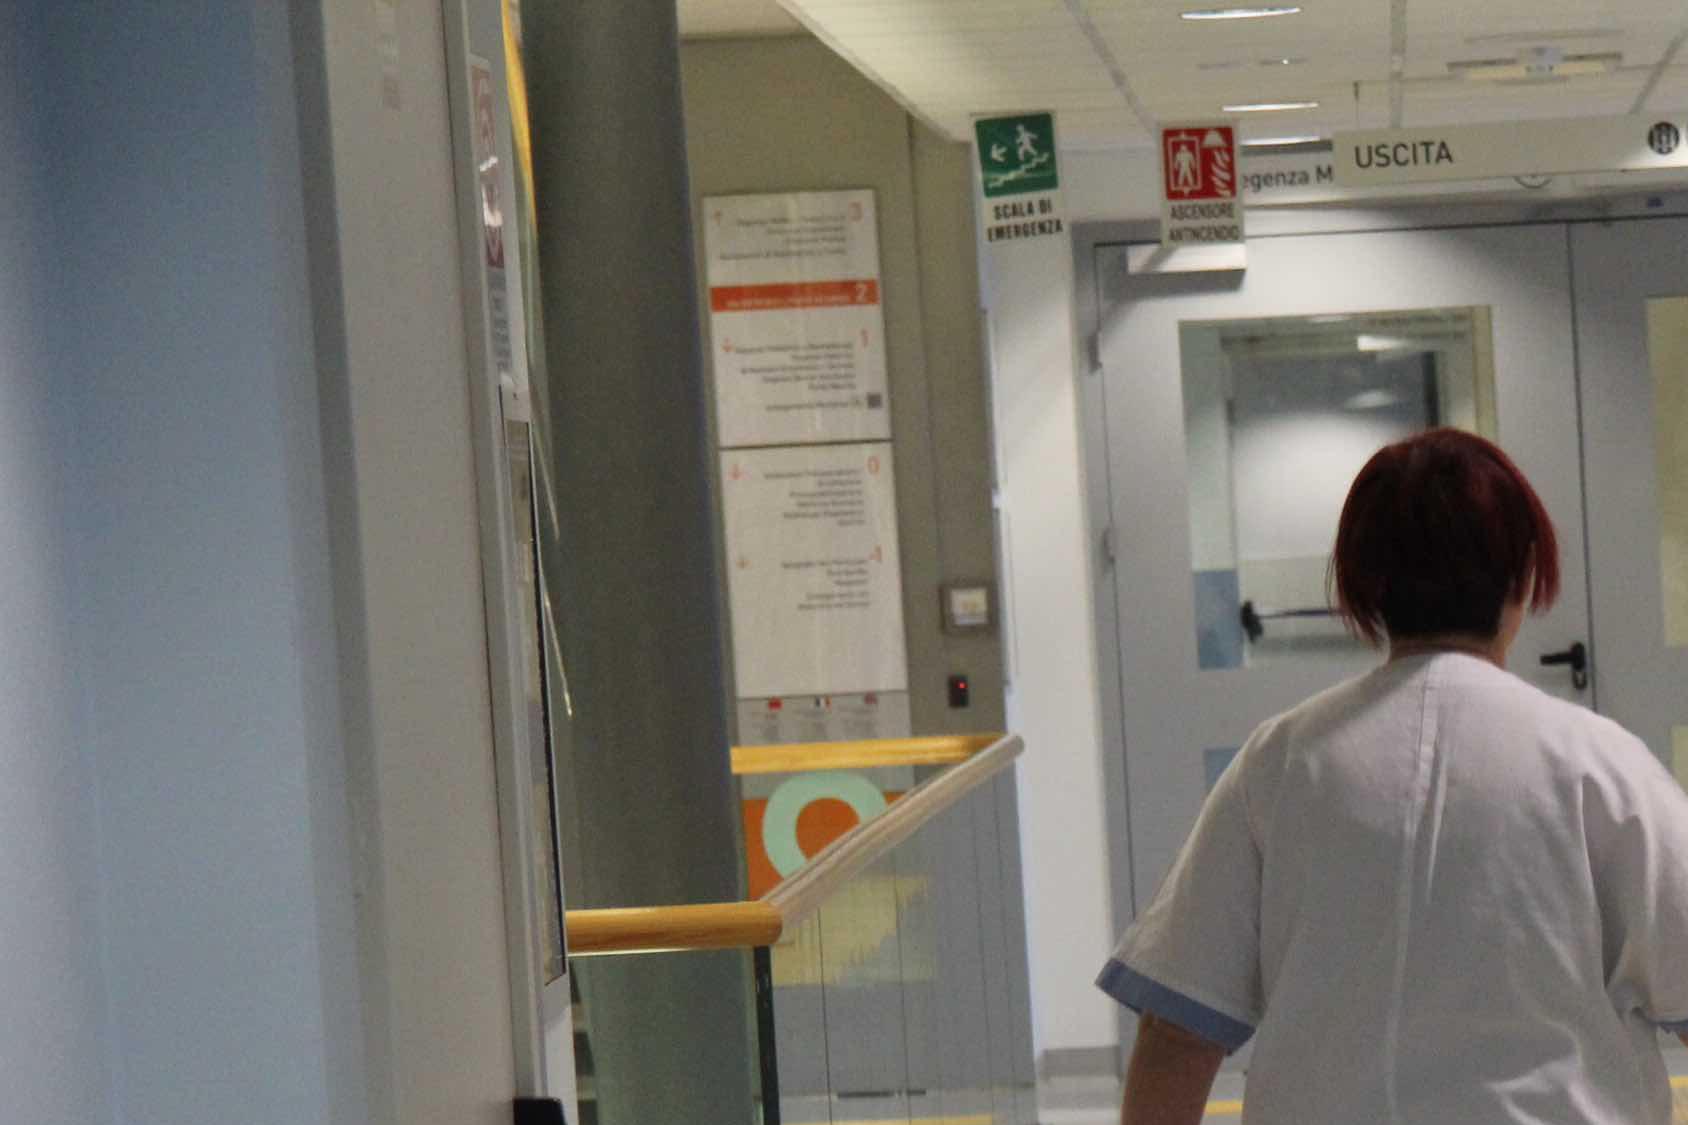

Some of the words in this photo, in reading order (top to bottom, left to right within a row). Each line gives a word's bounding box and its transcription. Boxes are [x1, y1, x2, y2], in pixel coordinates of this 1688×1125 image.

[1355, 142, 1454, 169] USCITA
[994, 204, 1034, 220] SCALA
[1038, 201, 1053, 216] DI
[1170, 204, 1235, 221] ASCENSORE
[987, 220, 1063, 242] EMERGENZA
[1169, 224, 1240, 242] ANTINCENDIO
